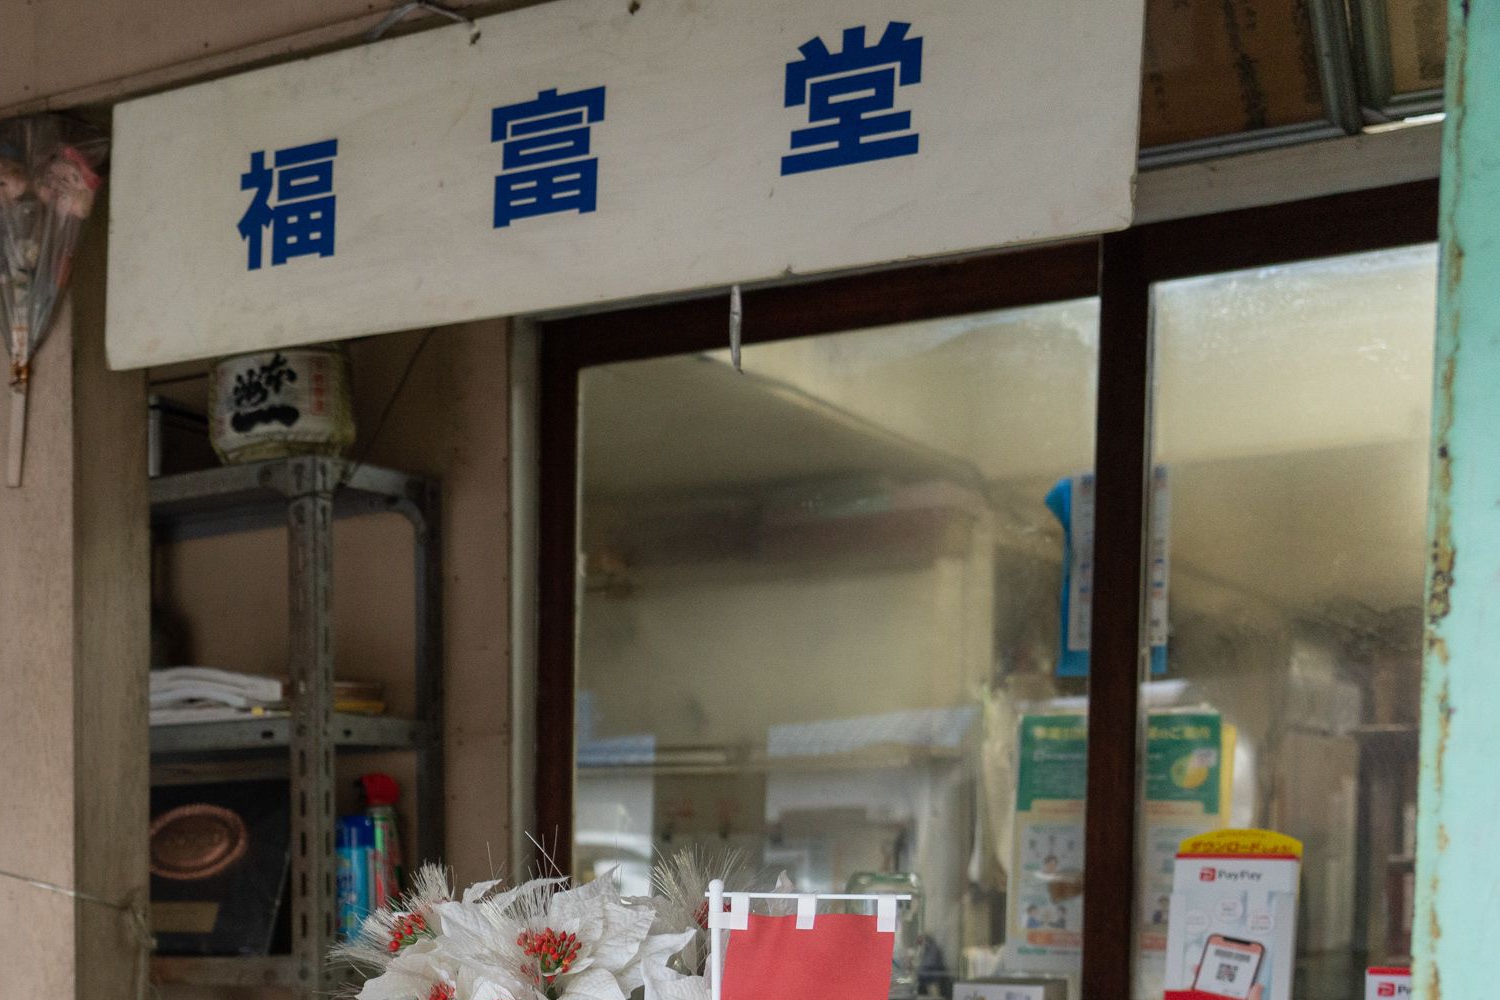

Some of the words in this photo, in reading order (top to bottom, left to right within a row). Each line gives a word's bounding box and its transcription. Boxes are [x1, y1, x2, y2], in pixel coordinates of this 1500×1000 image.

[237, 21, 923, 270] 福富堂
[1218, 869, 1262, 881] PayPay
